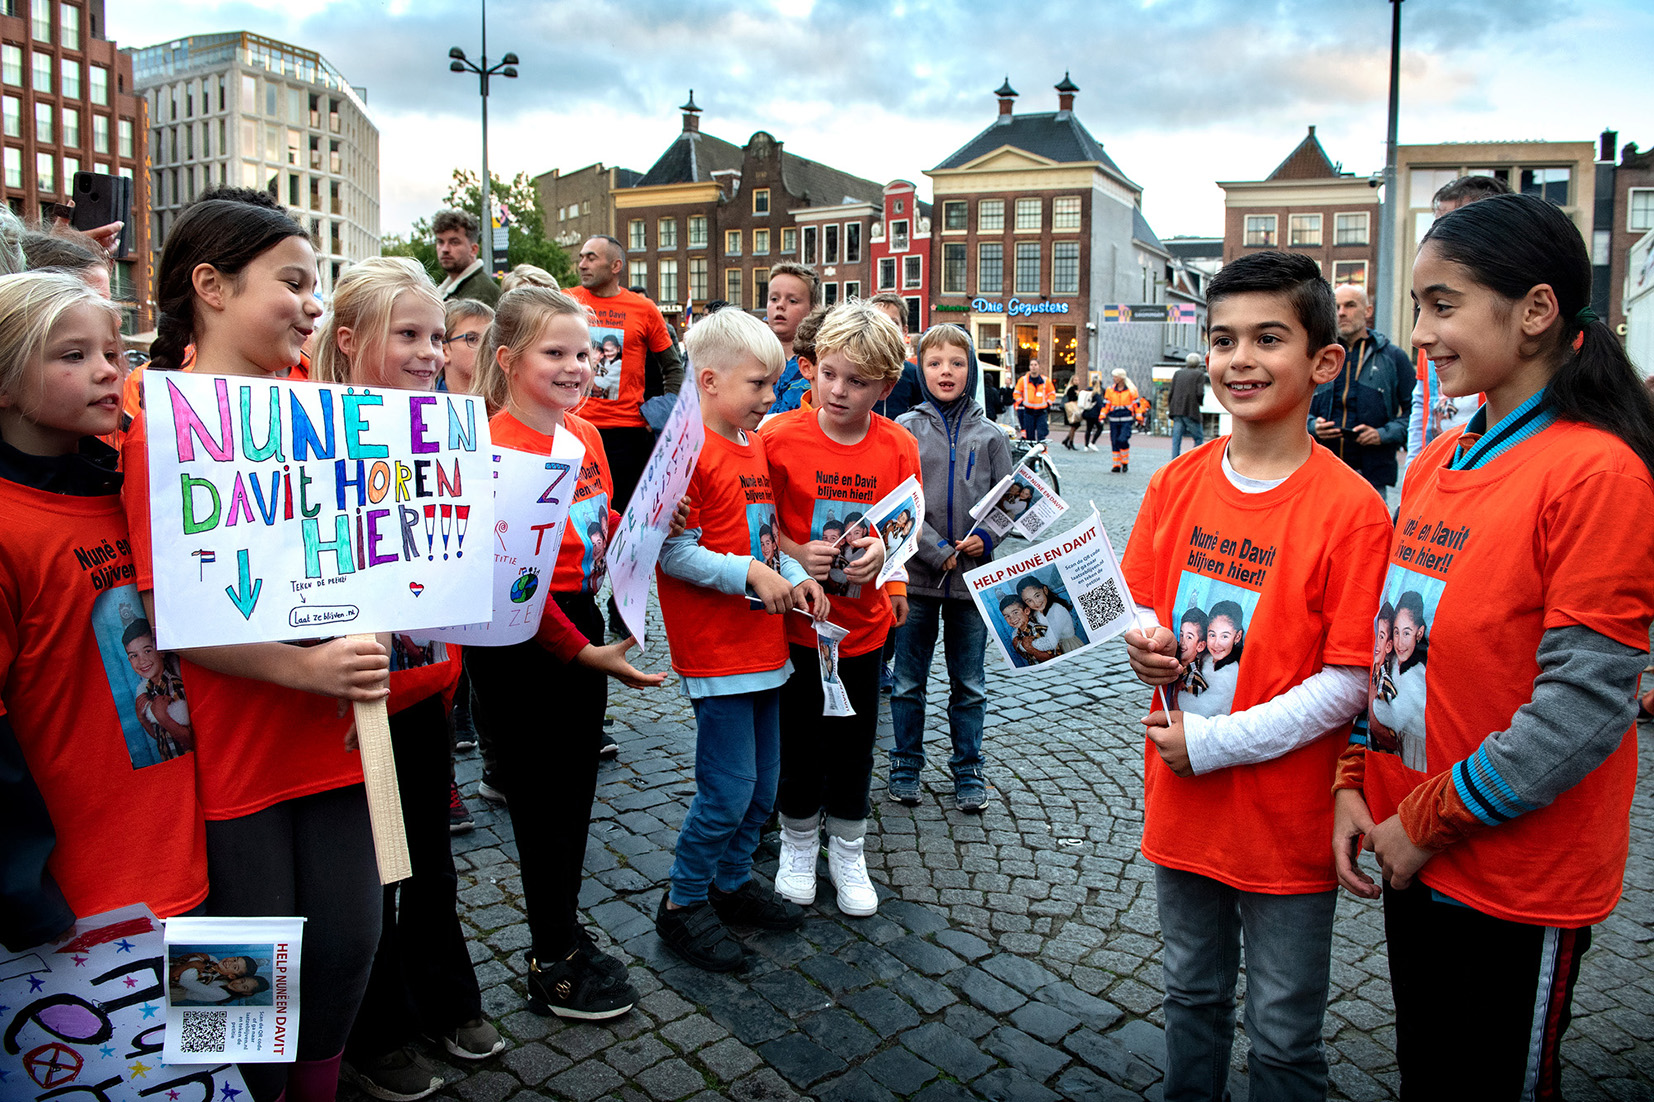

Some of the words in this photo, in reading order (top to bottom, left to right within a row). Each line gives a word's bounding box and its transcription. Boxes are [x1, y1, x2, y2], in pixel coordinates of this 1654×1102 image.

[609, 309, 626, 320] Davit
[971, 297, 1003, 313] Drie
[1008, 297, 1069, 317] Gezusters
[409, 396, 477, 454] EN
[334, 457, 462, 511] HOREN
[816, 470, 840, 485] Nunë
[842, 475, 852, 486] en
[855, 474, 877, 489] Davit
[818, 485, 848, 500] blijven
[850, 488, 873, 501] hier!!
[1019, 469, 1032, 480] HELP
[1043, 490, 1051, 498] EN
[1049, 497, 1065, 511] DAVIT
[1190, 525, 1219, 551] Nunë
[1220, 539, 1237, 557] en
[1238, 538, 1277, 567] Davit
[1430, 521, 1471, 551] Davit
[73, 538, 117, 571] Nunë
[973, 570, 1004, 590] HELP
[1006, 553, 1043, 576] NUNË
[1044, 547, 1062, 562] EN
[1063, 526, 1096, 554] DAVIT
[1187, 550, 1225, 575] blijven
[1227, 561, 1266, 586] hier!!
[1415, 546, 1454, 574] hier!!
[90, 564, 136, 591] blijven
[317, 579, 325, 587] DE
[294, 611, 310, 624] Laat
[276, 943, 288, 974] HELP
[276, 975, 290, 999] NUNË
[276, 1001, 288, 1014] EN
[243, 1012, 251, 1050] laatzeblijven.nl
[273, 1016, 287, 1056] DAVIT
